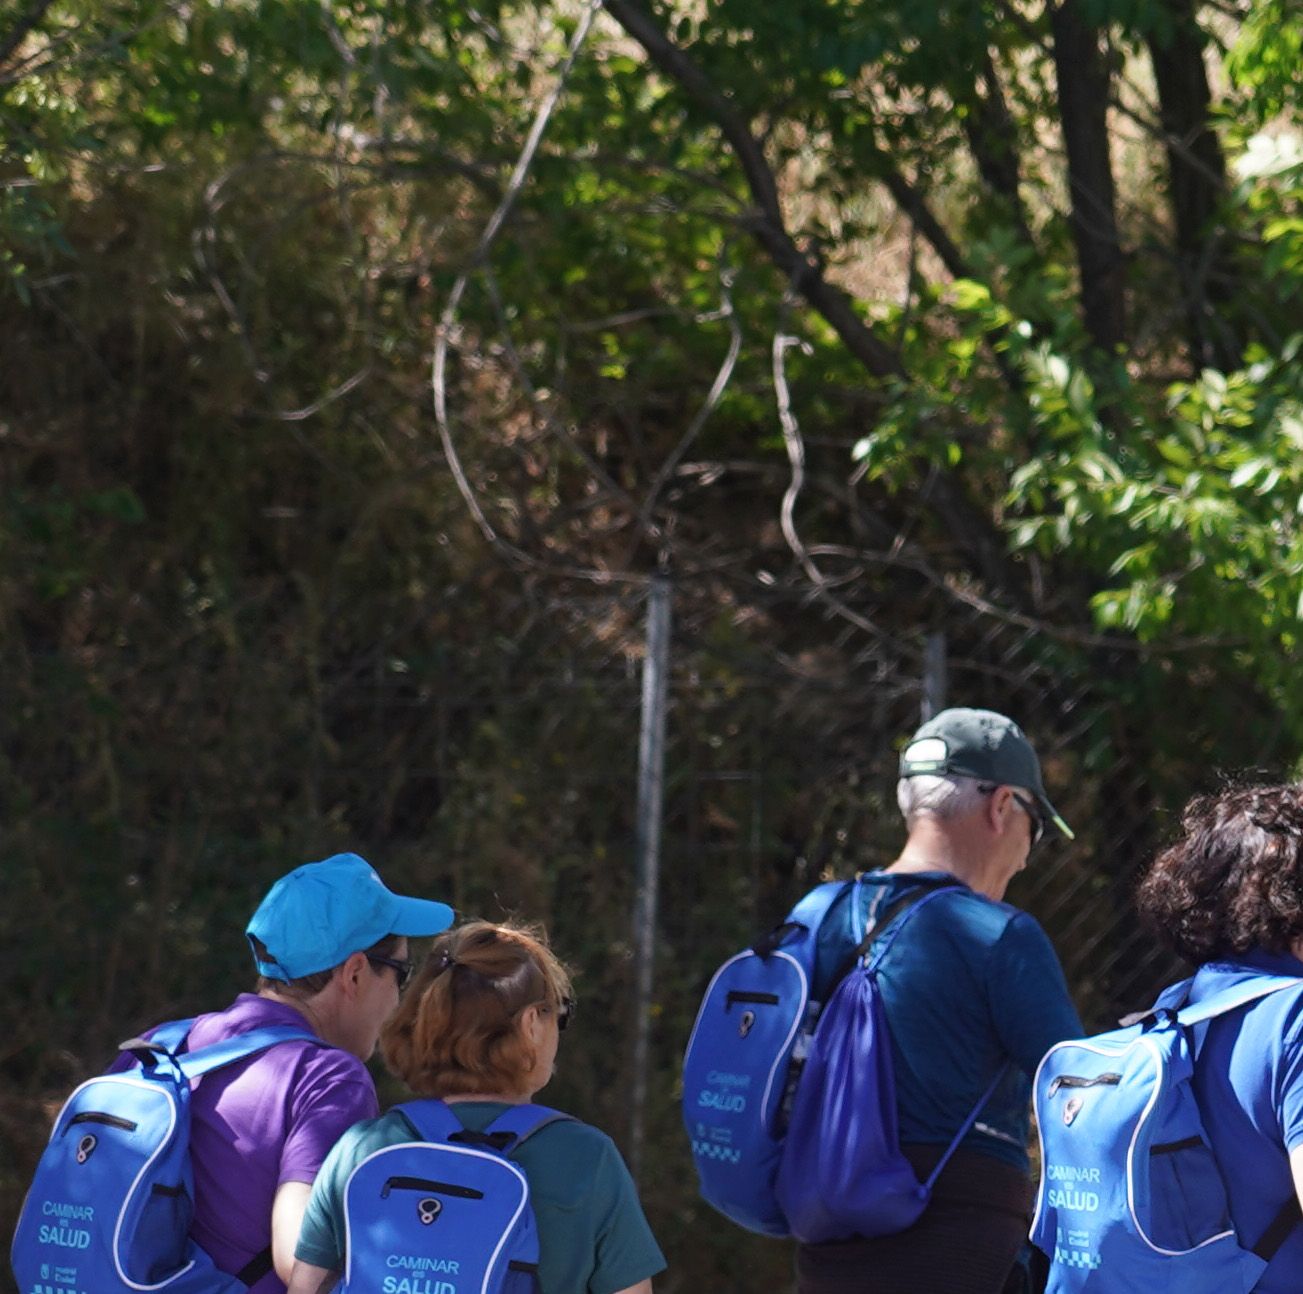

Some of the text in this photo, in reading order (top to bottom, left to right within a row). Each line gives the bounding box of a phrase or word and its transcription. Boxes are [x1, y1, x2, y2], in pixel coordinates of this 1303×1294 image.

[698, 1090, 746, 1113] SALUD
[1047, 1165, 1100, 1183] CAMINAR
[1048, 1189, 1099, 1211] SALUD
[43, 1201, 94, 1221] CAMINAR
[39, 1225, 90, 1249] SALUD
[386, 1255, 460, 1275] CAMINAR
[412, 1271, 425, 1279] es
